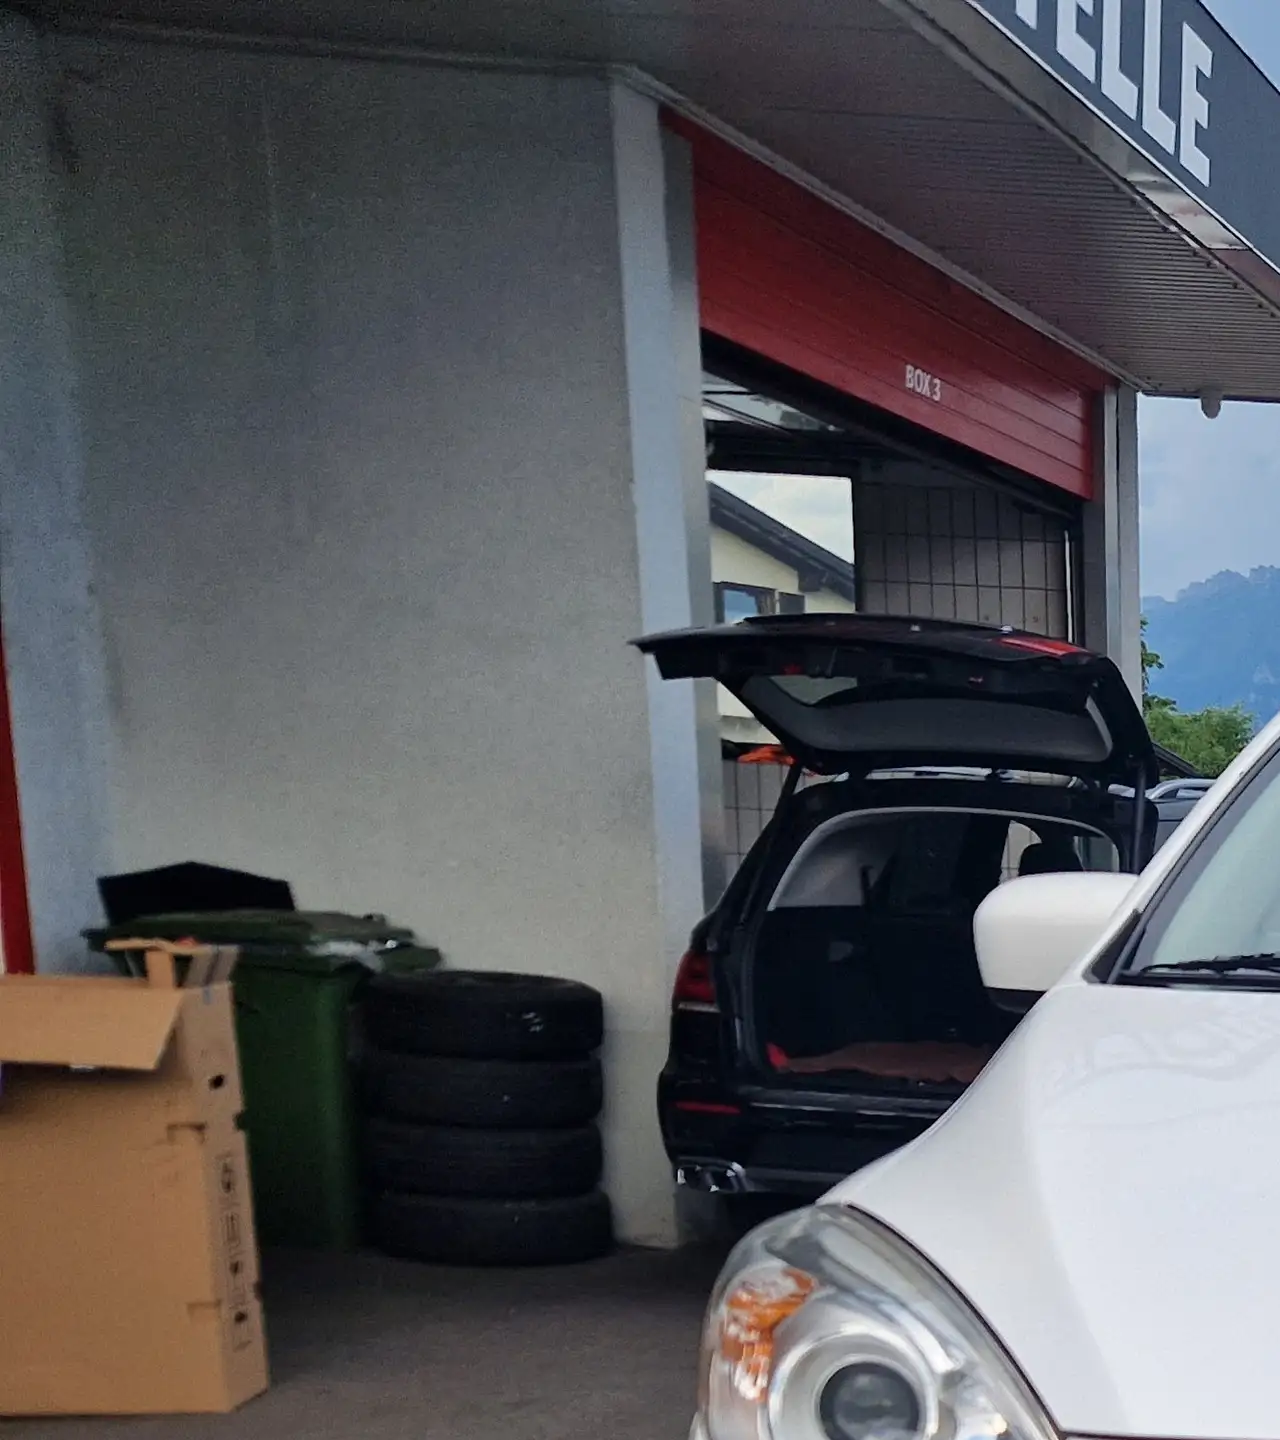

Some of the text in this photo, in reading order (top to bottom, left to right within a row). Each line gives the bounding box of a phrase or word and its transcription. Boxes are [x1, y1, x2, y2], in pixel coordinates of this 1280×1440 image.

[1015, 0, 1212, 188] LLE
[905, 364, 941, 401] BOX 3
